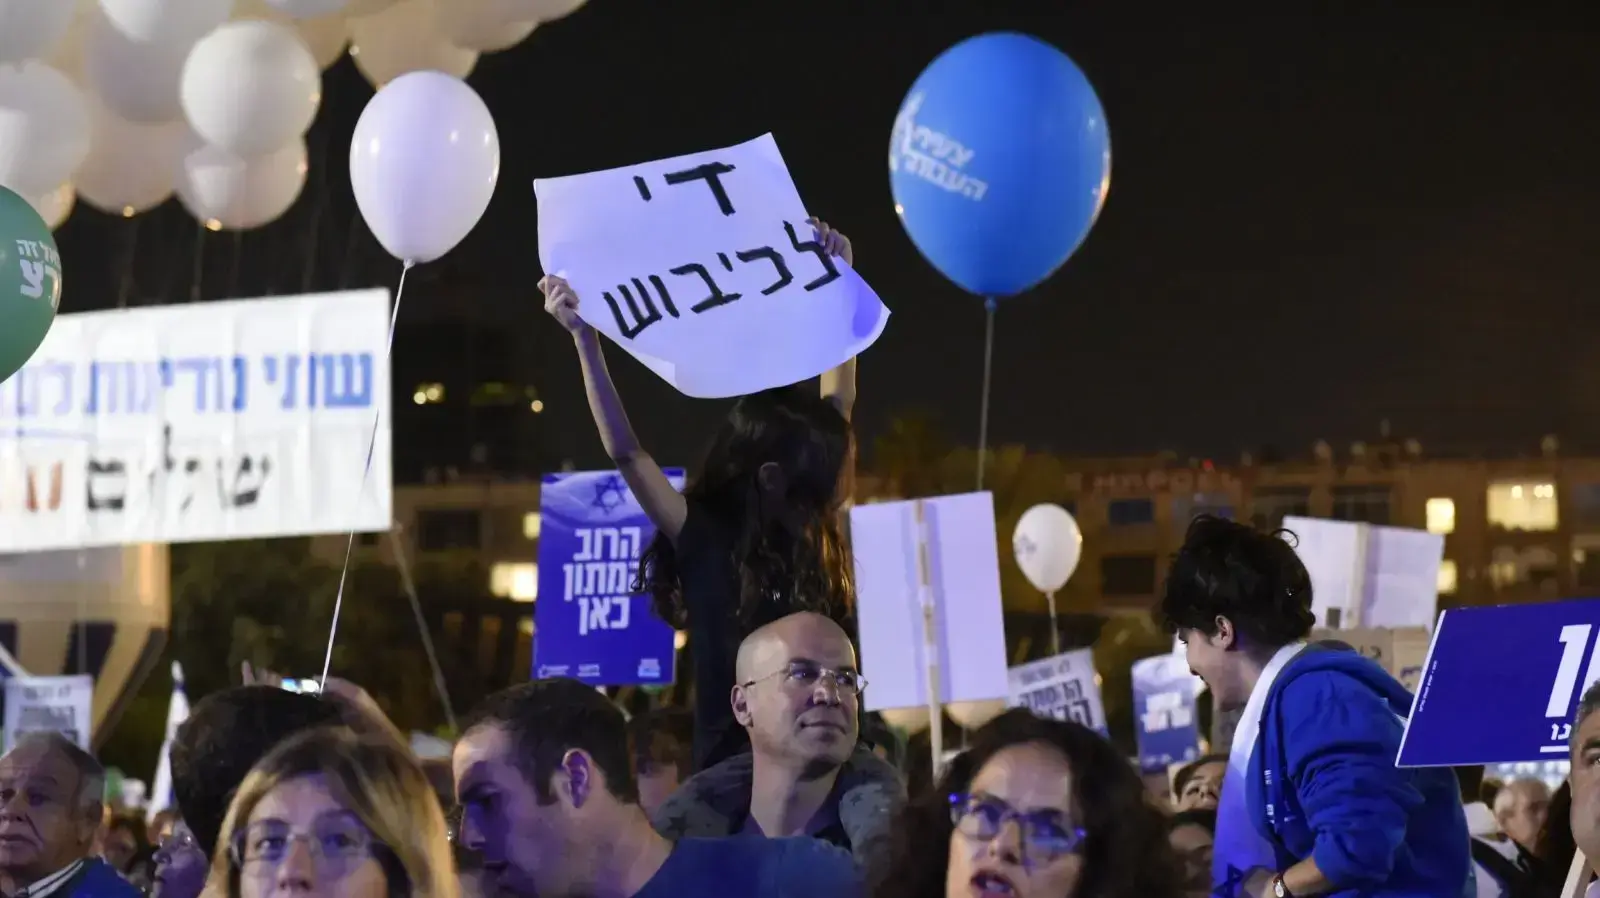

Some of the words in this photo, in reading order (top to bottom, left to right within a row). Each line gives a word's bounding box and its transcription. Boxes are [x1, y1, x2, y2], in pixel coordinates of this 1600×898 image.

[633, 161, 738, 217] די
[16, 240, 39, 258] זה
[20, 259, 60, 309] רצ
[602, 220, 843, 341] לכיבוש
[573, 526, 641, 562] הרוב
[562, 561, 641, 602] המתון
[577, 596, 630, 636] כאן
[1551, 723, 1572, 741] נו
